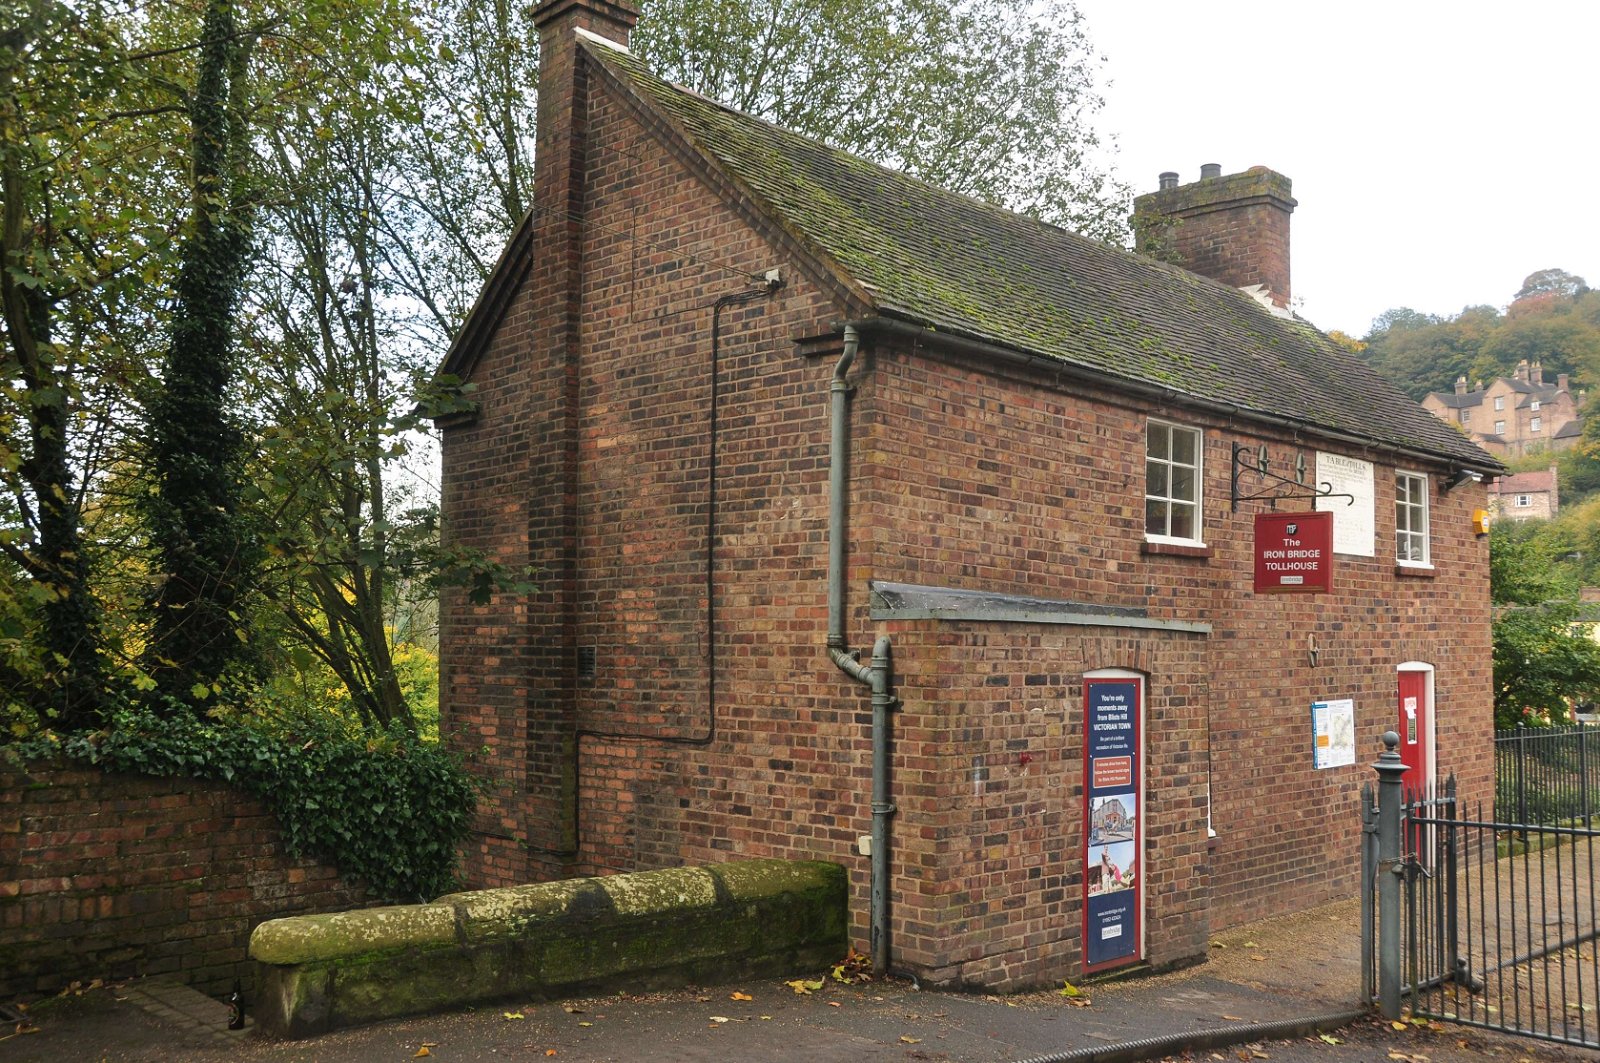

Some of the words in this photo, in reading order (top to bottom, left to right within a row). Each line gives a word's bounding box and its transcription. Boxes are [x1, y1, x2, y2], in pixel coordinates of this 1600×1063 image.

[1326, 456, 1345, 465] TABLE
[1283, 538, 1300, 546] The
[1264, 550, 1285, 558] IRON
[1288, 550, 1320, 558] BRIDGE
[1266, 562, 1318, 570] TOLLHOUSE
